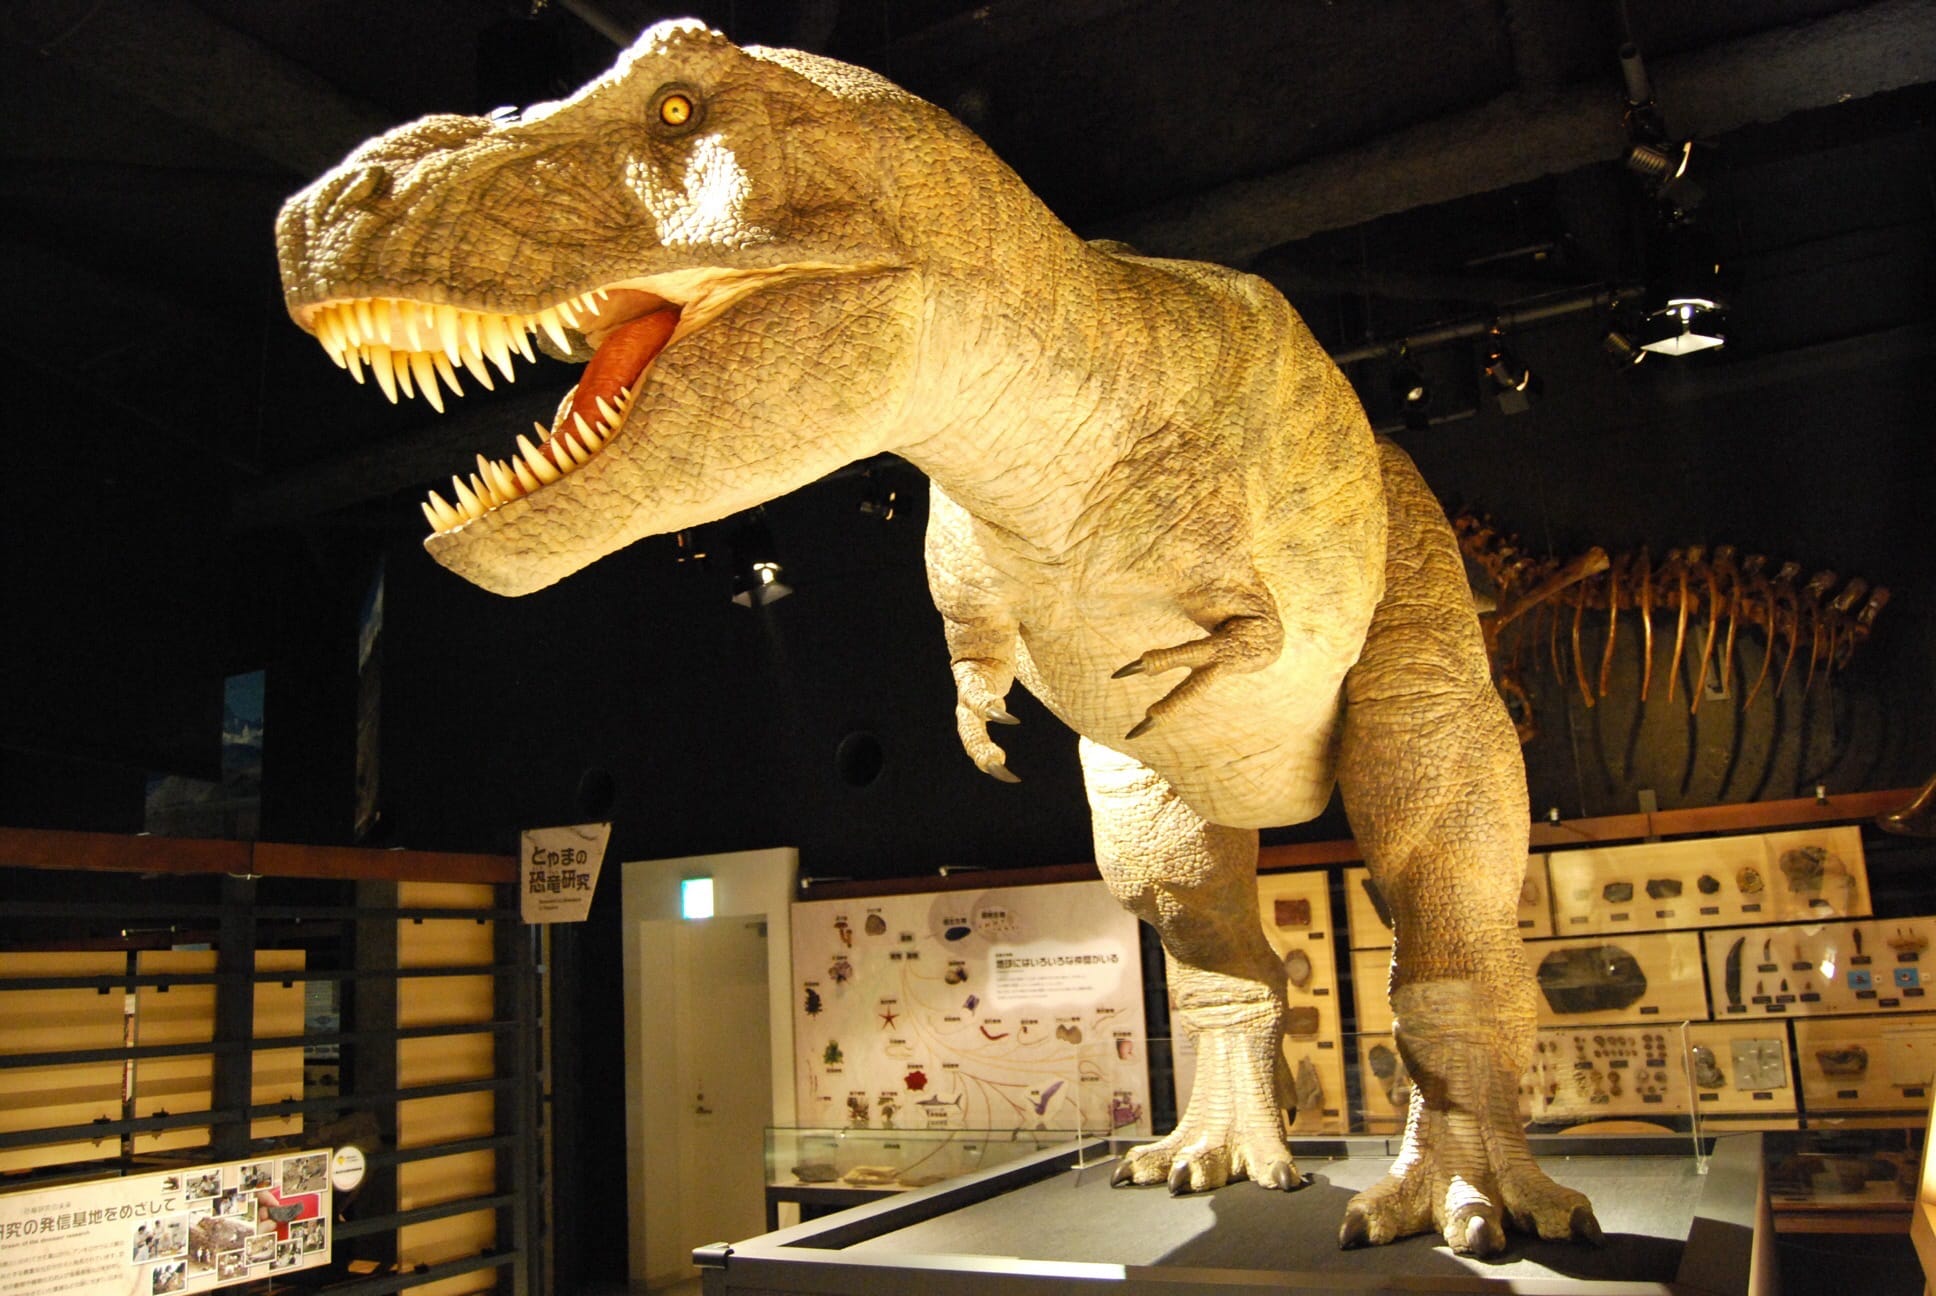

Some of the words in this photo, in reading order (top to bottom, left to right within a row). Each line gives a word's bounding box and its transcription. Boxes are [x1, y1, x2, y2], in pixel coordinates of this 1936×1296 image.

[532, 846, 588, 867] とやまの
[529, 870, 590, 894] 恐竜研究
